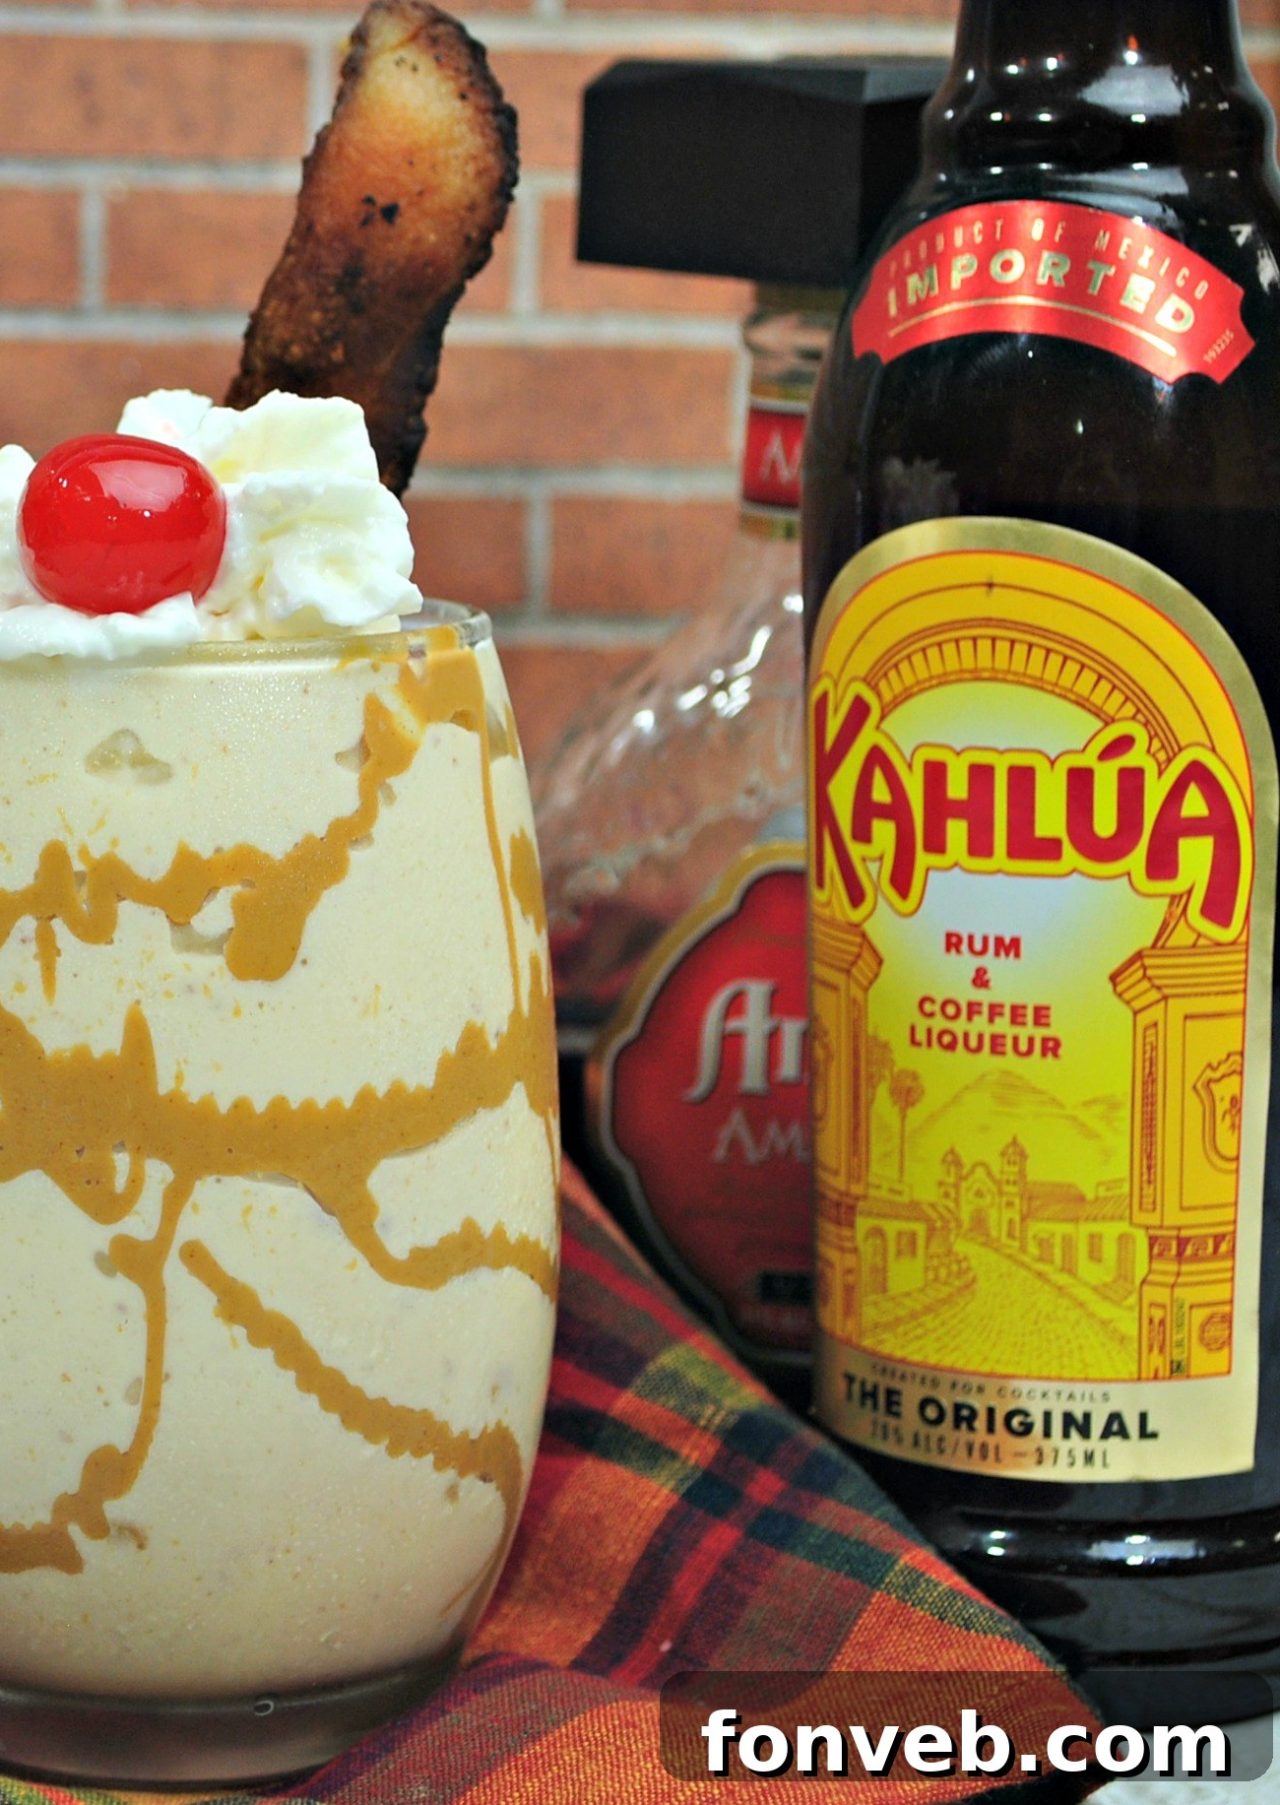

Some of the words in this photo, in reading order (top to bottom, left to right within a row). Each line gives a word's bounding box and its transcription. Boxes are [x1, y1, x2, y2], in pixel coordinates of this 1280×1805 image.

[889, 218, 1004, 278] PRODUCT
[1031, 217, 1067, 242] OF
[1095, 229, 1209, 300] MEXICO
[888, 248, 1196, 334] IMPORTED
[811, 686, 1244, 934] KAHLÚA
[944, 931, 1023, 959] RUM
[971, 966, 992, 989] &
[918, 995, 1052, 1028] COFFEE
[908, 1025, 1063, 1059] LIQUEUR
[843, 1372, 903, 1419] THE
[918, 1396, 1161, 1441] ORIGINAL
[950, 1379, 987, 1395] FOR
[997, 1386, 1111, 1403] COCKTAILS
